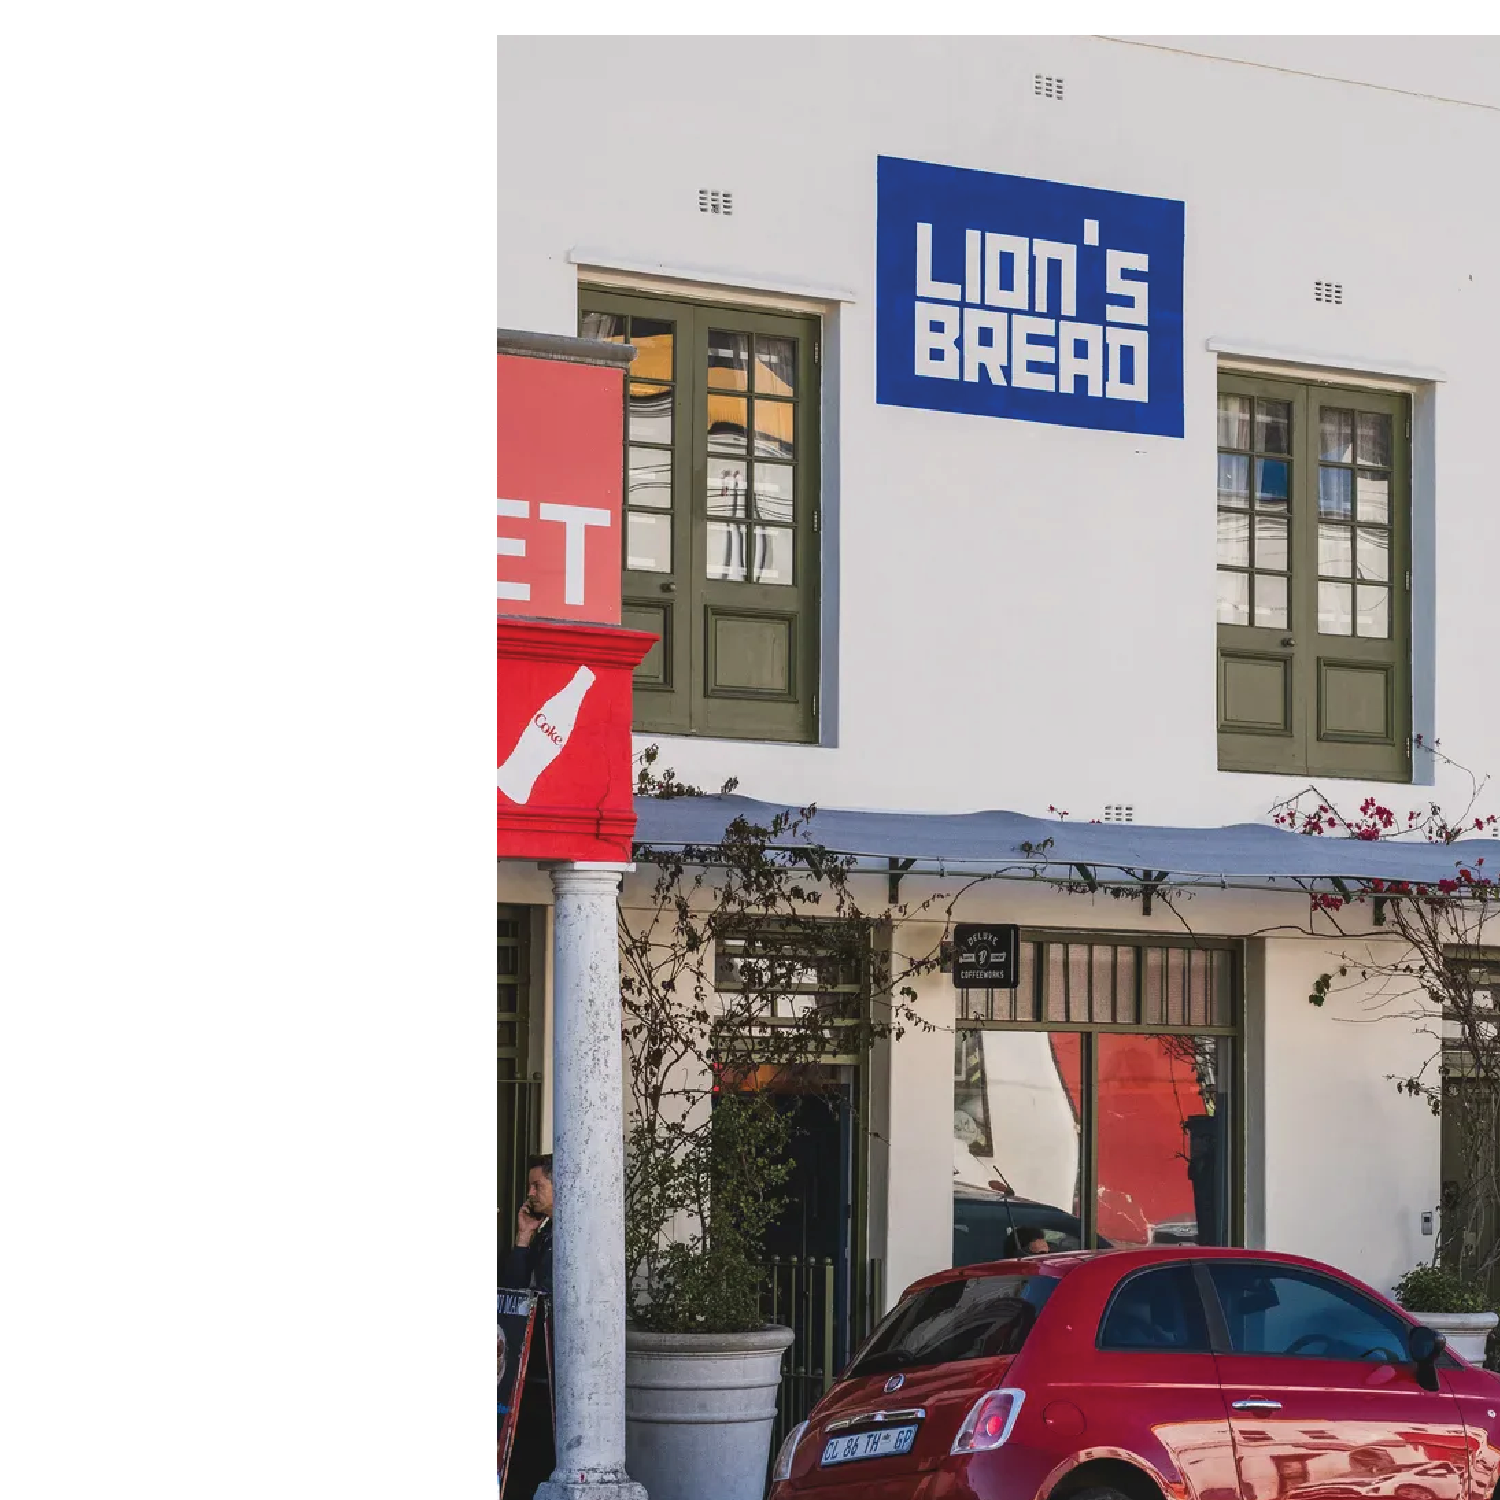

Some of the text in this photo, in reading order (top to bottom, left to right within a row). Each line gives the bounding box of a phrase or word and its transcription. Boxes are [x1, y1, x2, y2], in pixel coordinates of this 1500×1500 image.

[916, 218, 1150, 327] LION'S
[914, 300, 1150, 404] BREAD
[534, 713, 563, 747] Coke
[960, 969, 1004, 979] COFFEEWORKS
[894, 1429, 913, 1451] GP
